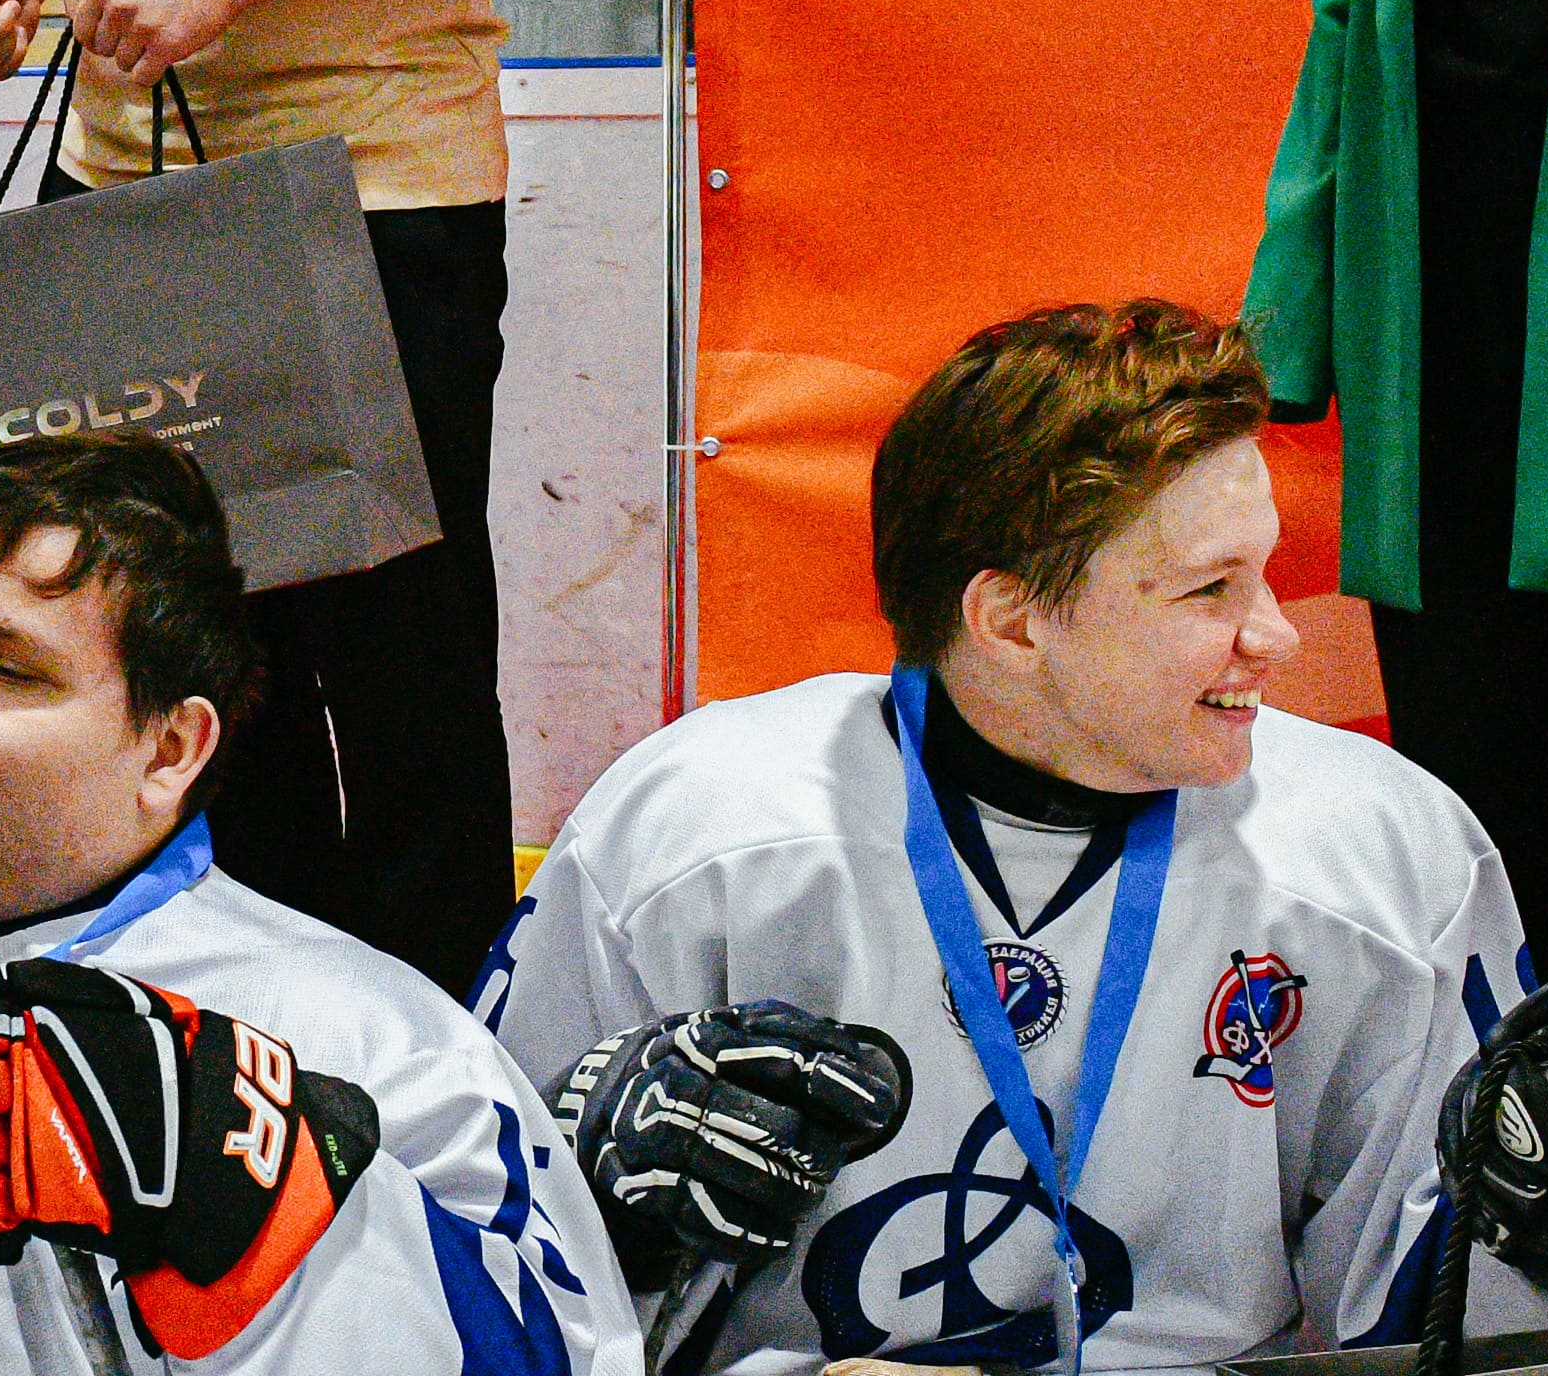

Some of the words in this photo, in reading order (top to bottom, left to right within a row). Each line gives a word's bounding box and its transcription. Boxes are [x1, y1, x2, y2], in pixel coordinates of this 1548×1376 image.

[155, 415, 222, 440] опмент
[985, 946, 1058, 989] ЕДЕРАЦИЯ
[1018, 996, 1059, 1043] ХОККЕЯ
